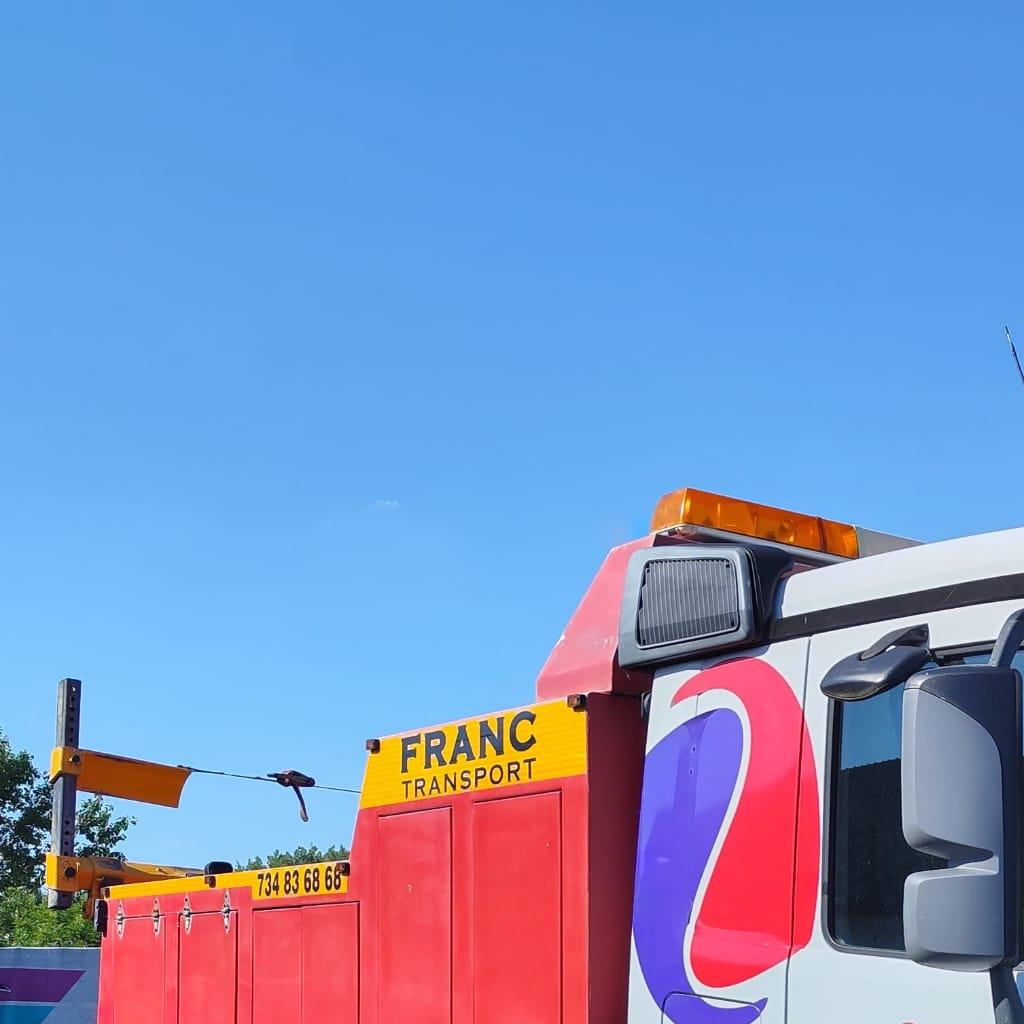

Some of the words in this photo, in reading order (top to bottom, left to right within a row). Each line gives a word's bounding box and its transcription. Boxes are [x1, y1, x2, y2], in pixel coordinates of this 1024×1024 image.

[401, 711, 537, 774] FRANC
[402, 757, 537, 799] TRANSPORT
[257, 871, 280, 897] 734
[283, 870, 300, 895] 83
[303, 868, 321, 893] 68
[324, 865, 342, 891] 68
